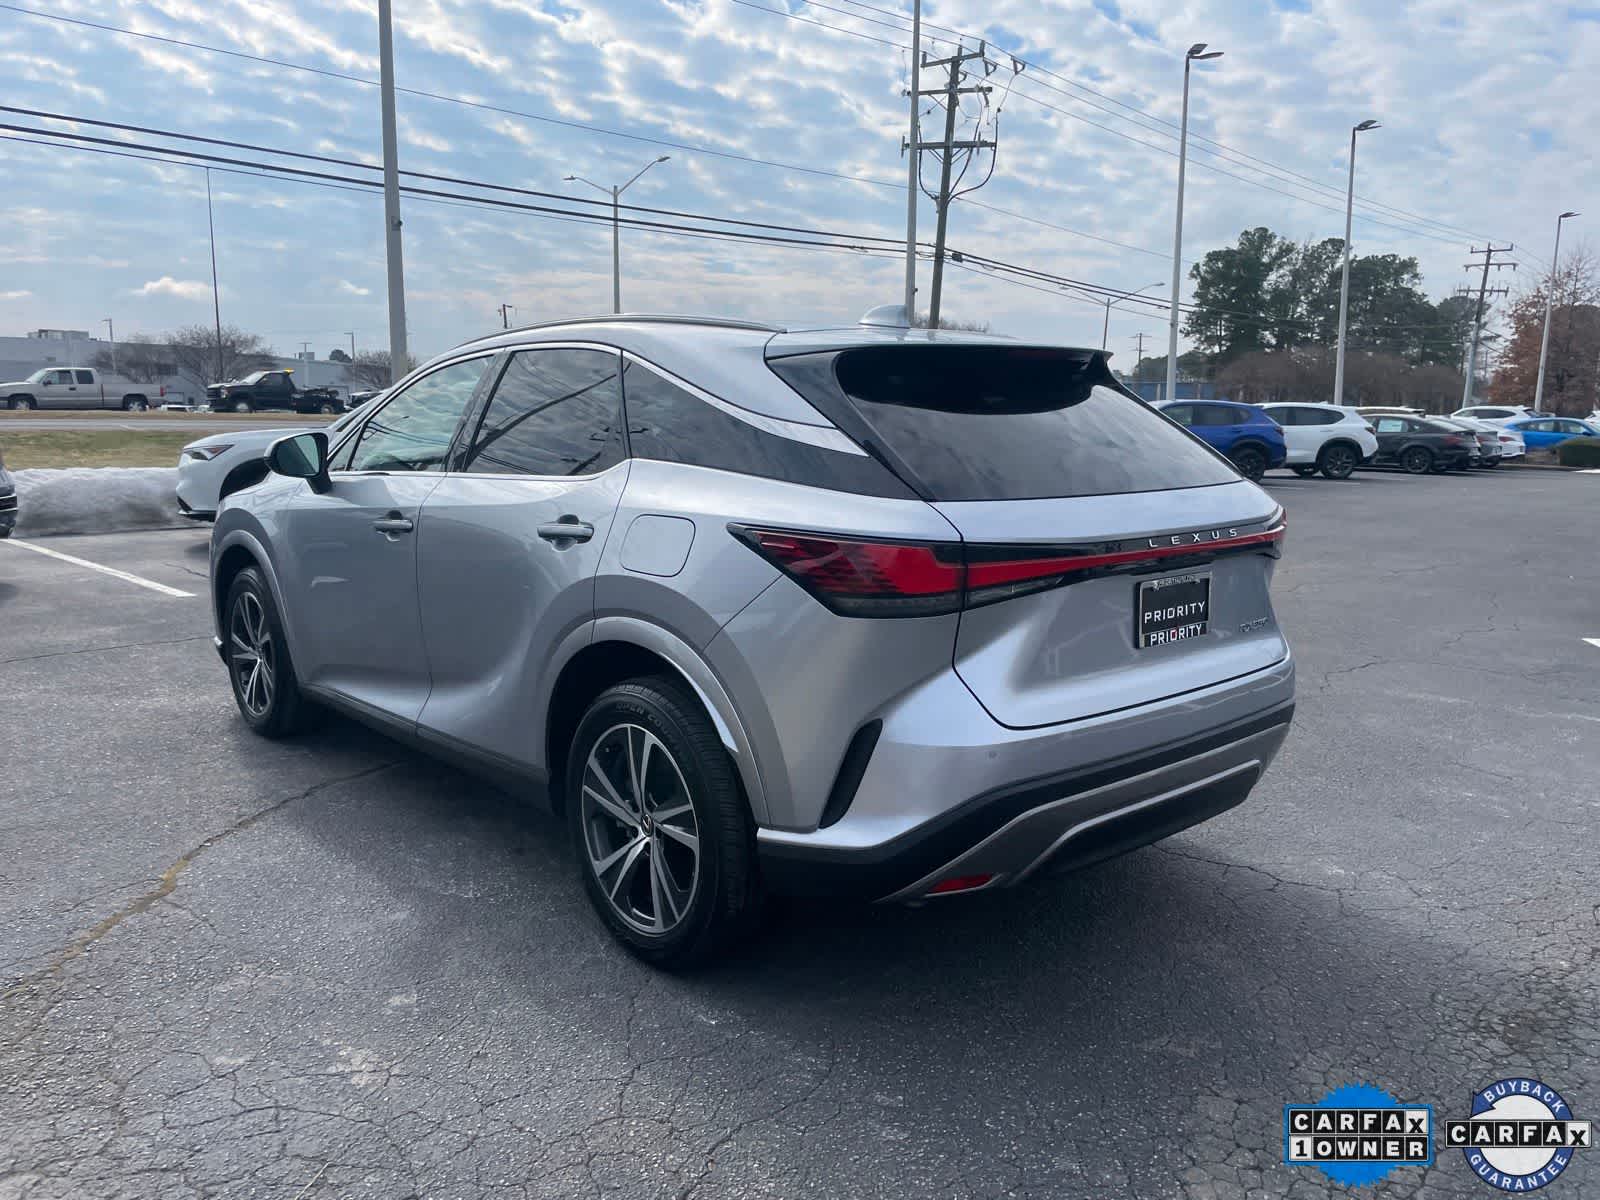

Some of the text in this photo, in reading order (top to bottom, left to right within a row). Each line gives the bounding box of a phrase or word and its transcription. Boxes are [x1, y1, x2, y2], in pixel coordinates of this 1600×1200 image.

[1148, 528, 1238, 548] LEXUS
[1144, 601, 1206, 624] PRIORITY
[1150, 623, 1202, 646] PRIORITY
